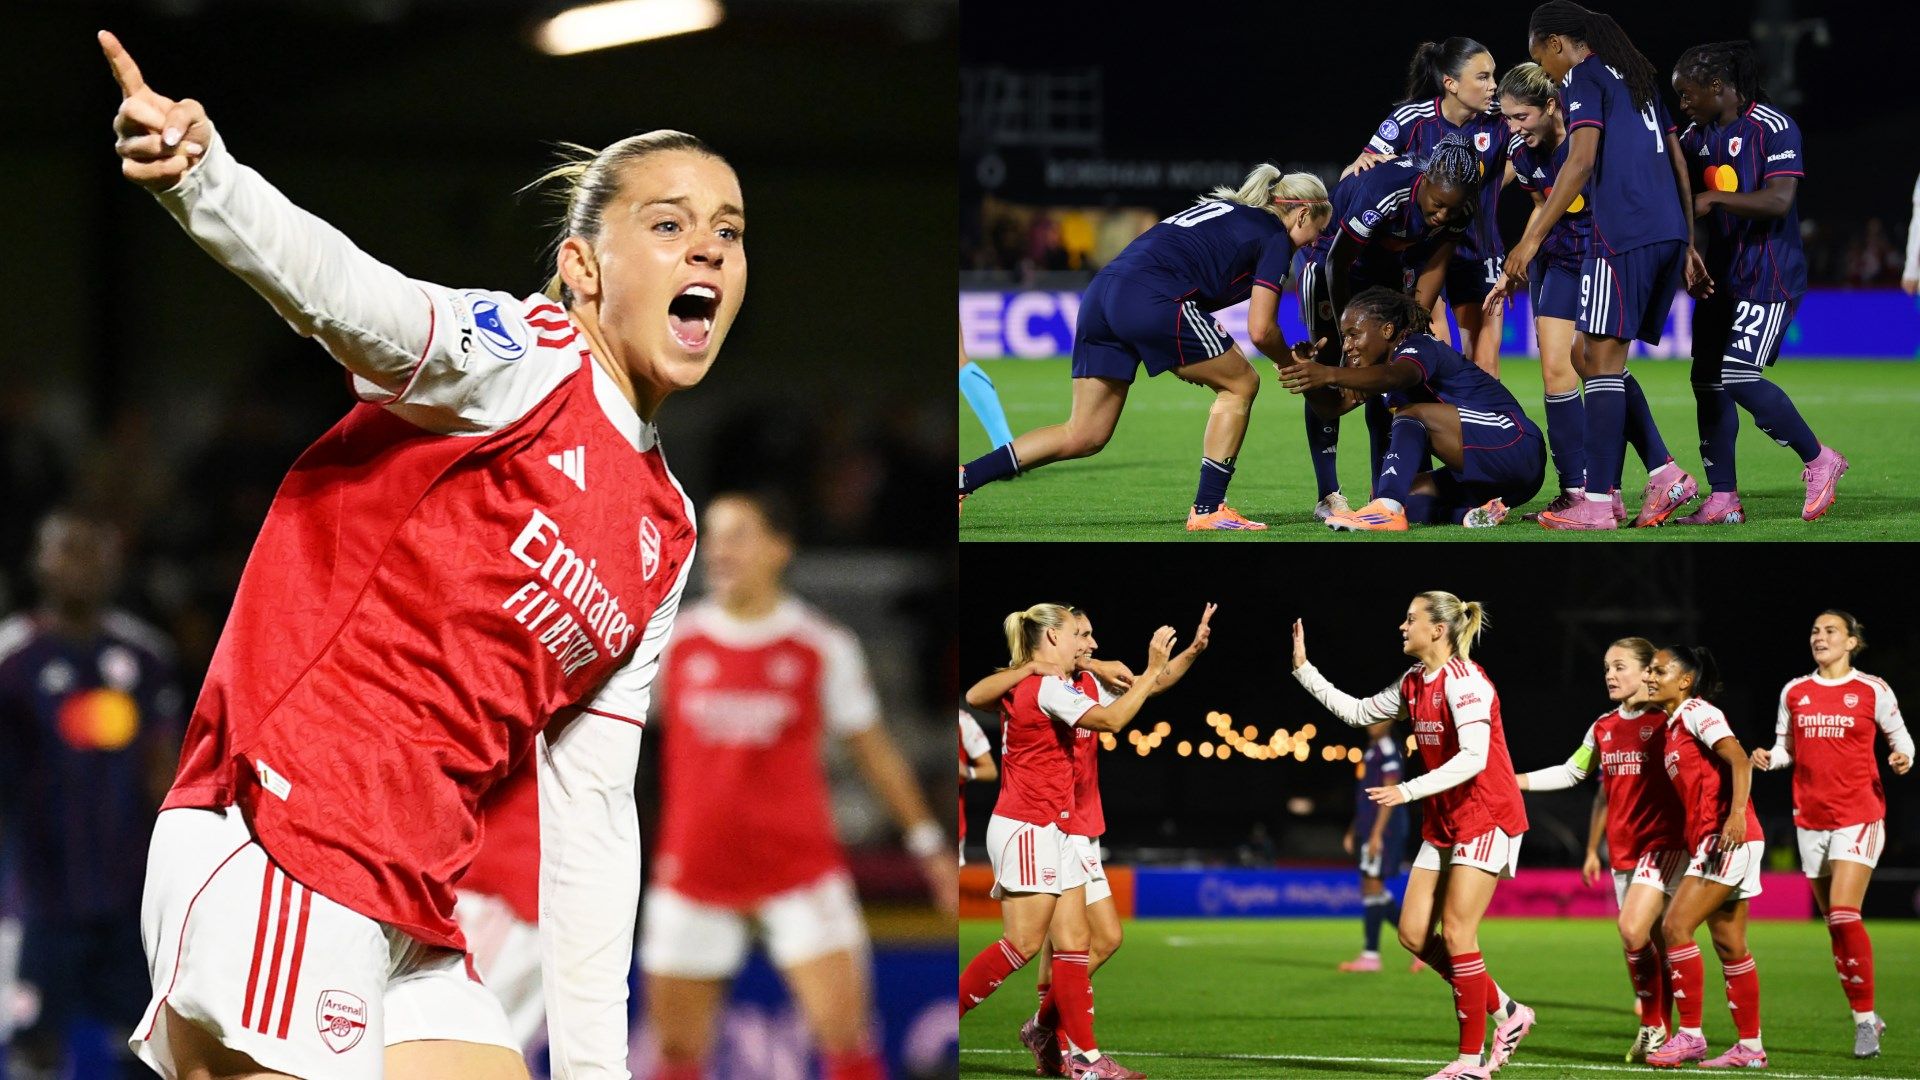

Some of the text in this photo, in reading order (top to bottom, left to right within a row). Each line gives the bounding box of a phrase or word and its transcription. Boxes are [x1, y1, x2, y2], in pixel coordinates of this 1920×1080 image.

[1581, 274, 1591, 307] 9
[1732, 301, 1765, 336] 22
[509, 508, 635, 658] Emirates
[501, 581, 560, 632] FLY
[1415, 718, 1444, 733] mirates
[1798, 712, 1855, 728] Emirates
[1805, 727, 1845, 738] FLY BETTER
[1601, 750, 1649, 764] Emirates
[1618, 764, 1641, 776] BETTER
[324, 999, 362, 1016] Arsenal
